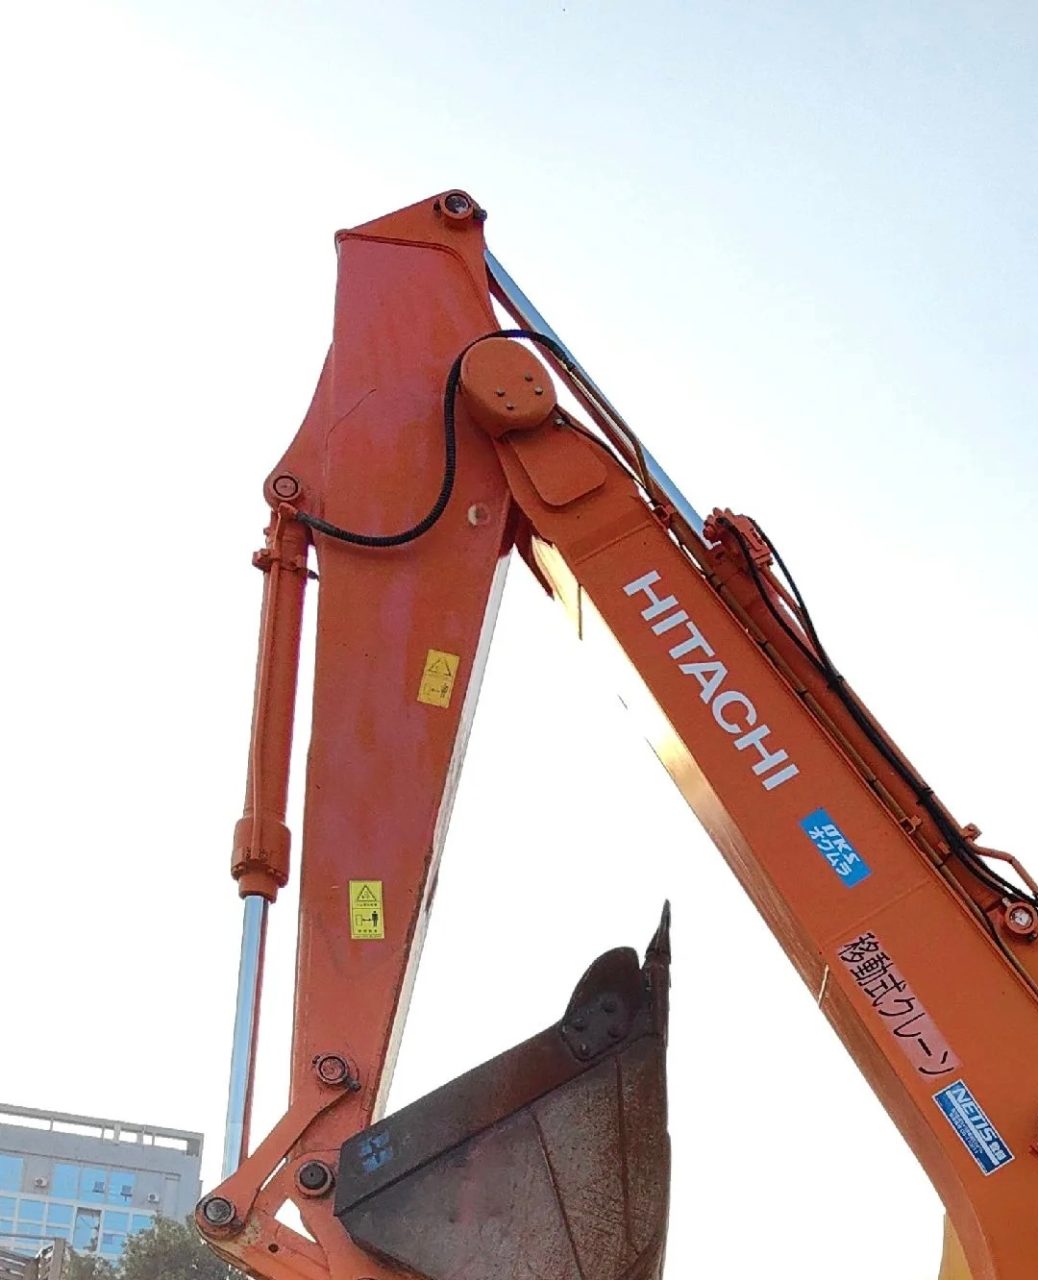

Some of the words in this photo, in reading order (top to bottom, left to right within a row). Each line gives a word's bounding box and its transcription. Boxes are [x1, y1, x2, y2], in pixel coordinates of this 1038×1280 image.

[623, 570, 800, 791] HITACHI
[808, 826, 853, 876] オクムラ
[838, 932, 954, 1075] 移動式クレーン
[950, 1087, 999, 1142] NETIS
